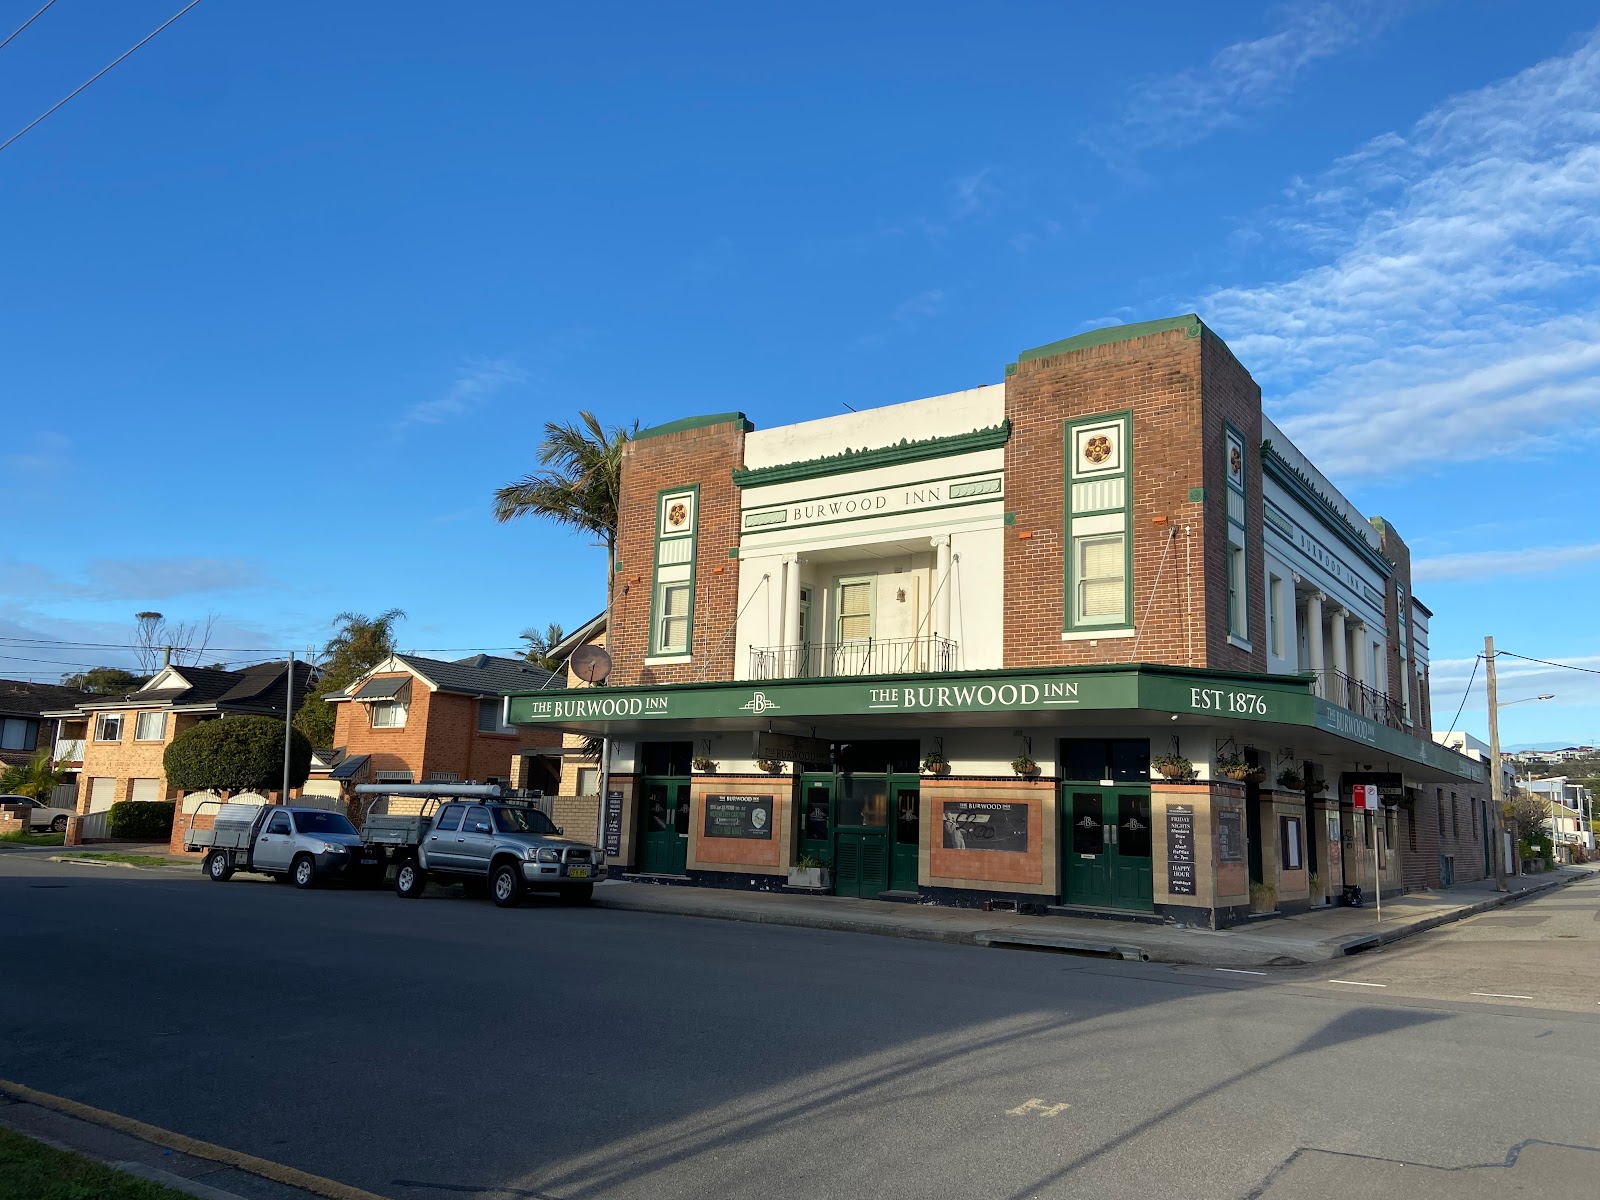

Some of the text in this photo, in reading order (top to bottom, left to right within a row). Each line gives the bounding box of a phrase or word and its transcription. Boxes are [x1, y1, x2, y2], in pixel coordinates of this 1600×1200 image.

[793, 488, 941, 521] BURWOOD INN
[1301, 534, 1341, 576] BURWOOD
[532, 697, 669, 717] THE BURWOOD INN
[869, 682, 1079, 708] THE BURWOOD INN
[1190, 687, 1267, 715] EST 1876
[1326, 706, 1336, 722] THE
[1336, 711, 1368, 740] BURWOOD
[776, 749, 816, 761] BURWOOD
